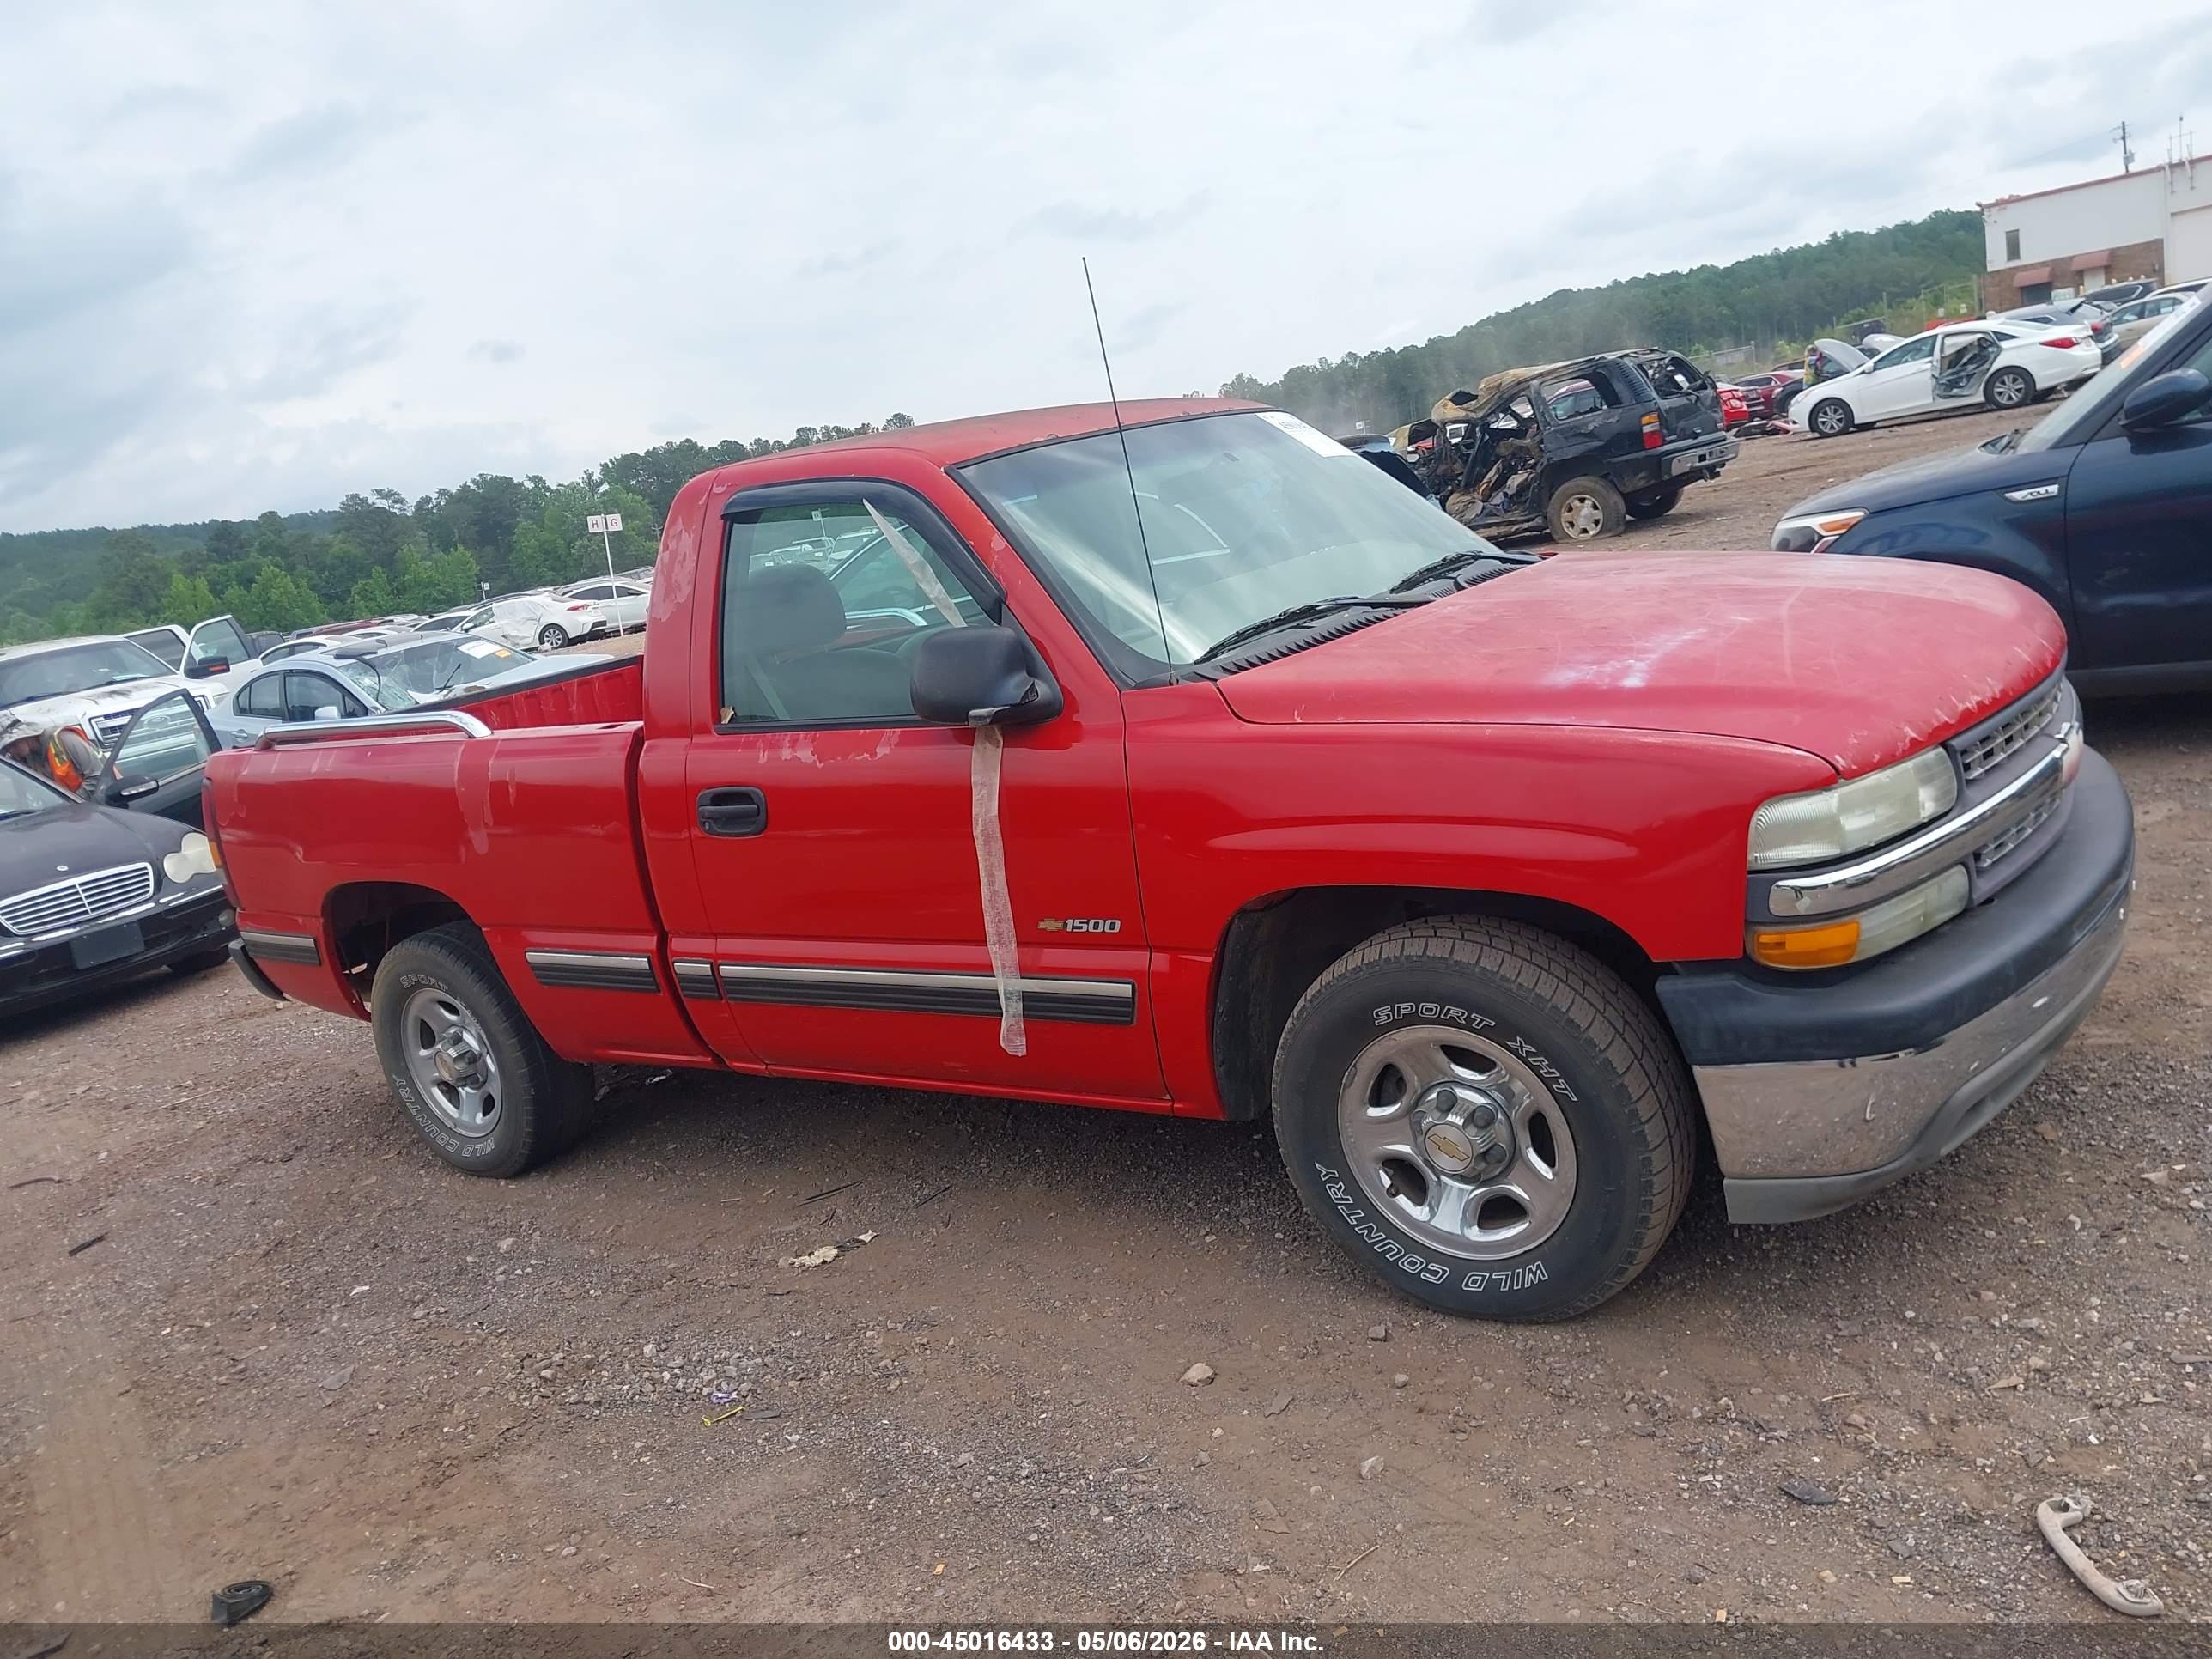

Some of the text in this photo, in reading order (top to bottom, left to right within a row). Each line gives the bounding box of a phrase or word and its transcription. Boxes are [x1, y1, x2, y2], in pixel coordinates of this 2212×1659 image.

[591, 519, 599, 529] H
[610, 518, 618, 527] G
[1065, 919, 1121, 933] 1500
[399, 974, 448, 992] SPORT
[1373, 1002, 1496, 1030] SPORT
[1505, 1036, 1578, 1102] XHT
[392, 1073, 495, 1157] WILD COUNTRY
[1314, 1160, 1548, 1291] WILD COUNTRY
